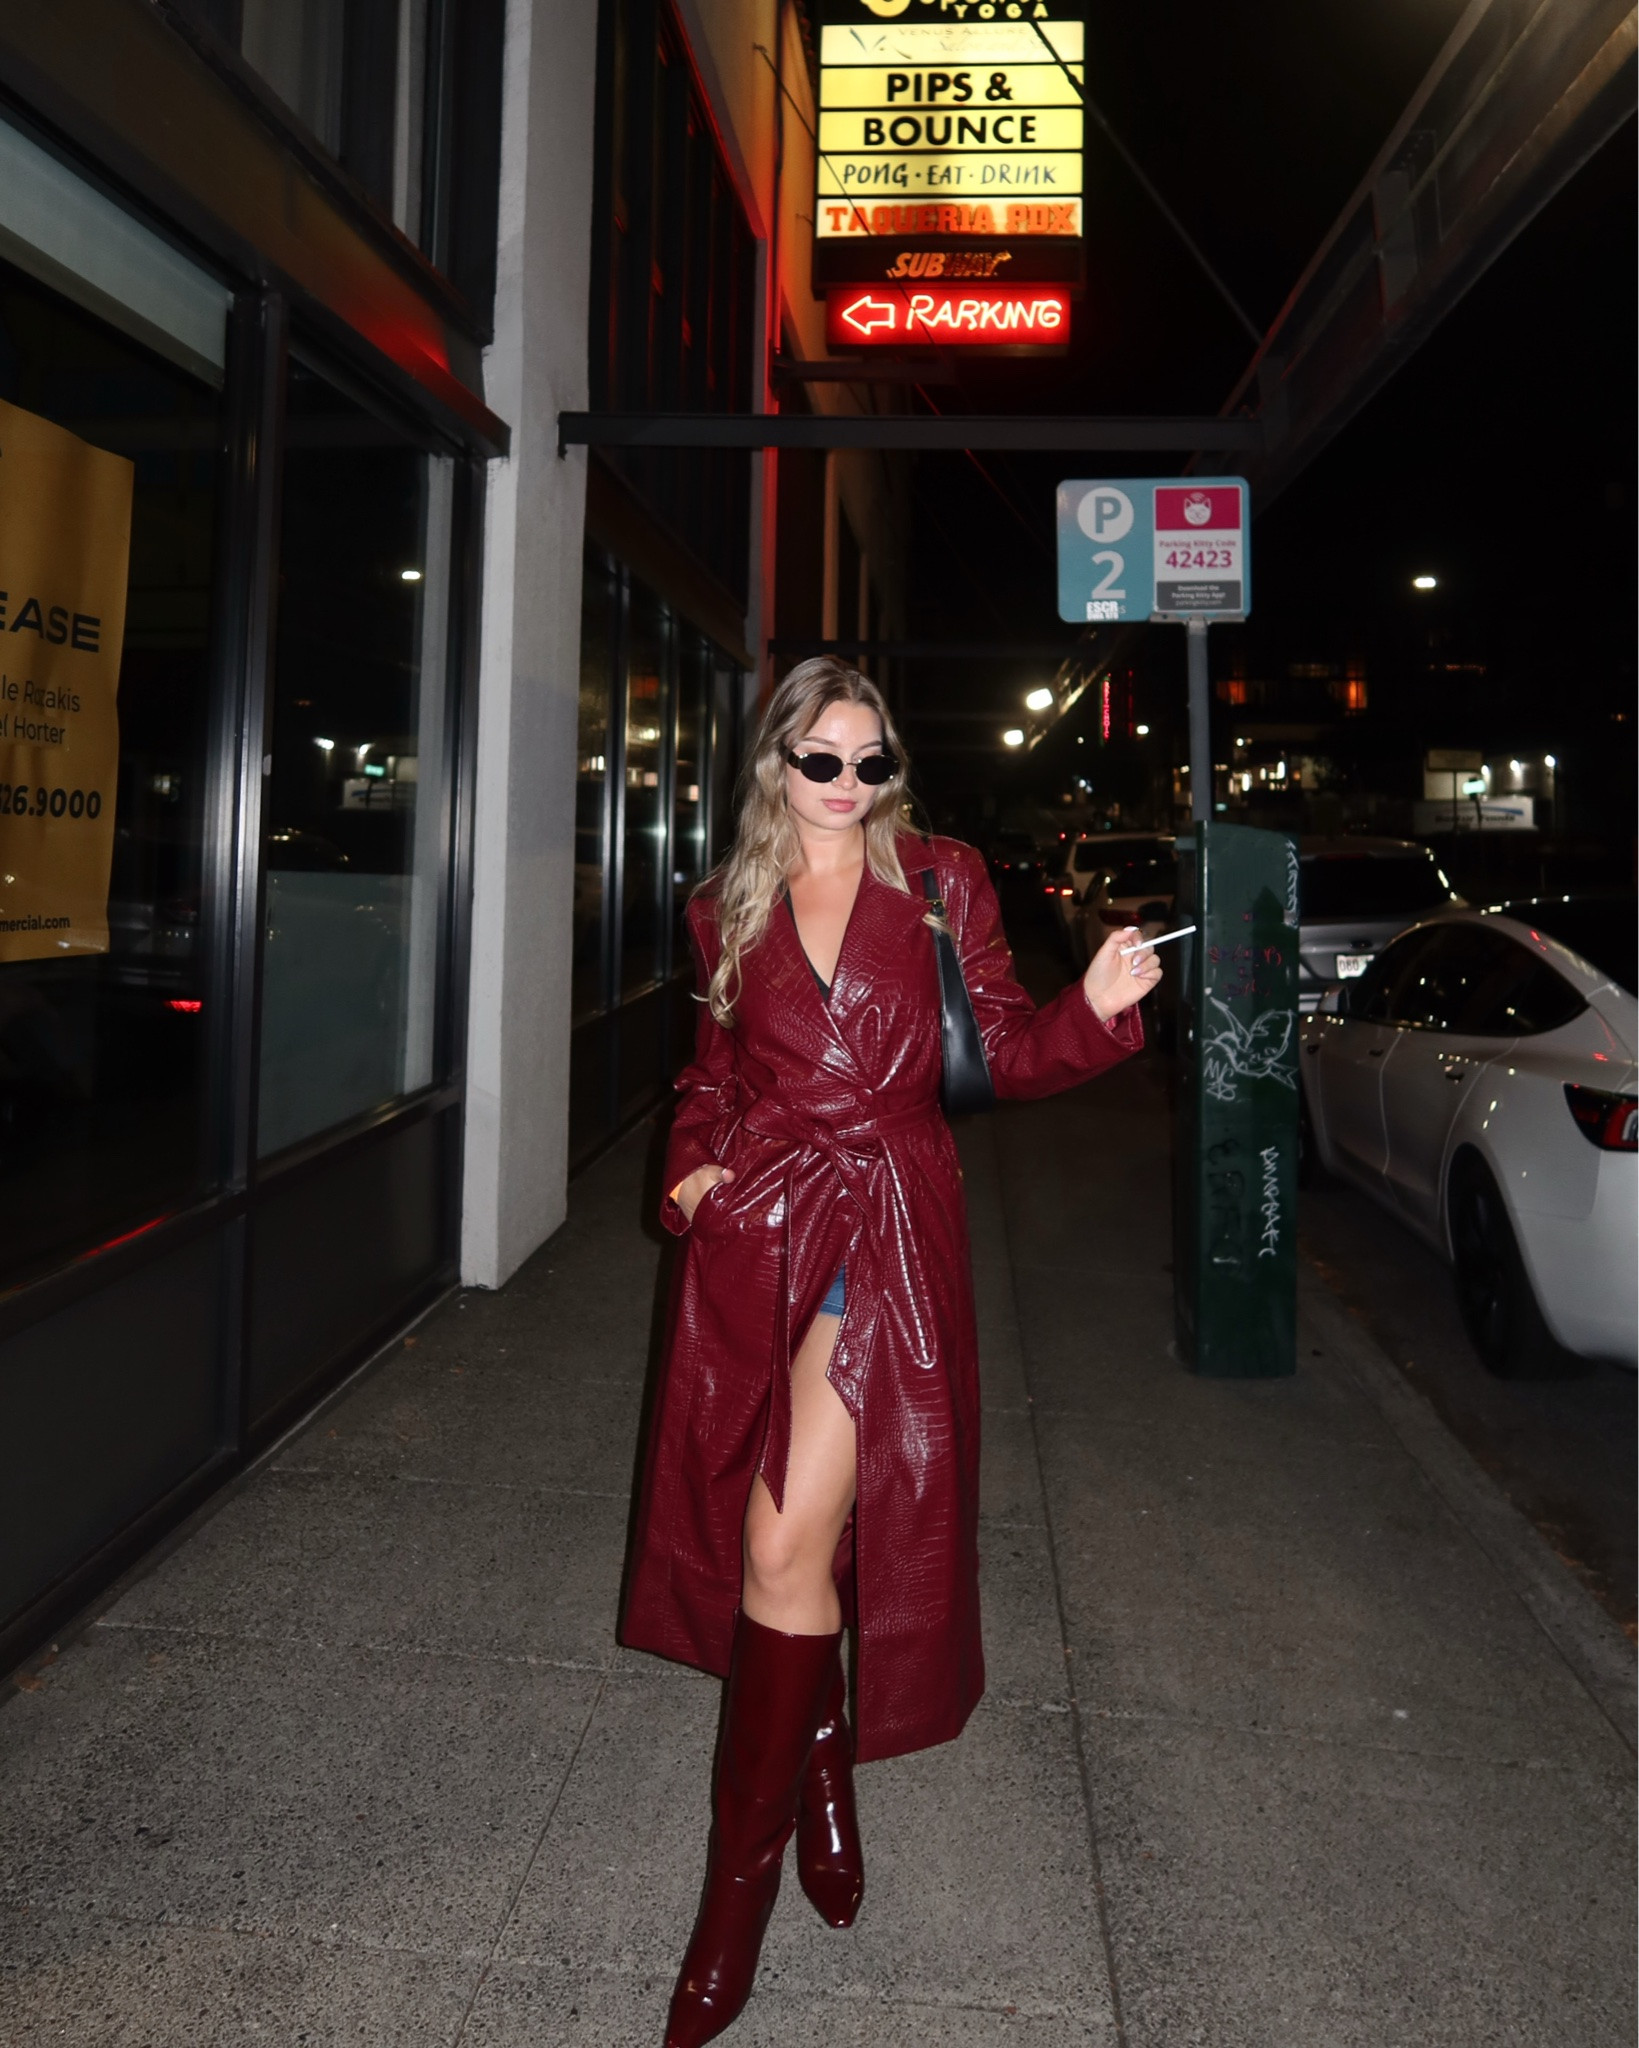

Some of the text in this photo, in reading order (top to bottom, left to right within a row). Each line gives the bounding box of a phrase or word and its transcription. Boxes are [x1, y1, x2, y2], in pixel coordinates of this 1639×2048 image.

[954, 3, 1048, 19] YOGA
[887, 72, 1013, 102] PIPS &
[864, 115, 1036, 146] BOUNCE
[843, 163, 1057, 187] PONG EAT DRINK
[826, 203, 1077, 234] TAQUERIA PDX
[886, 251, 1012, 278] SUBWAY
[1094, 496, 1122, 534] P
[1159, 539, 1236, 549] Parking Kitty Code
[1165, 550, 1232, 568] 42423
[1091, 550, 1126, 599] 2
[14, 716, 65, 744] Horter
